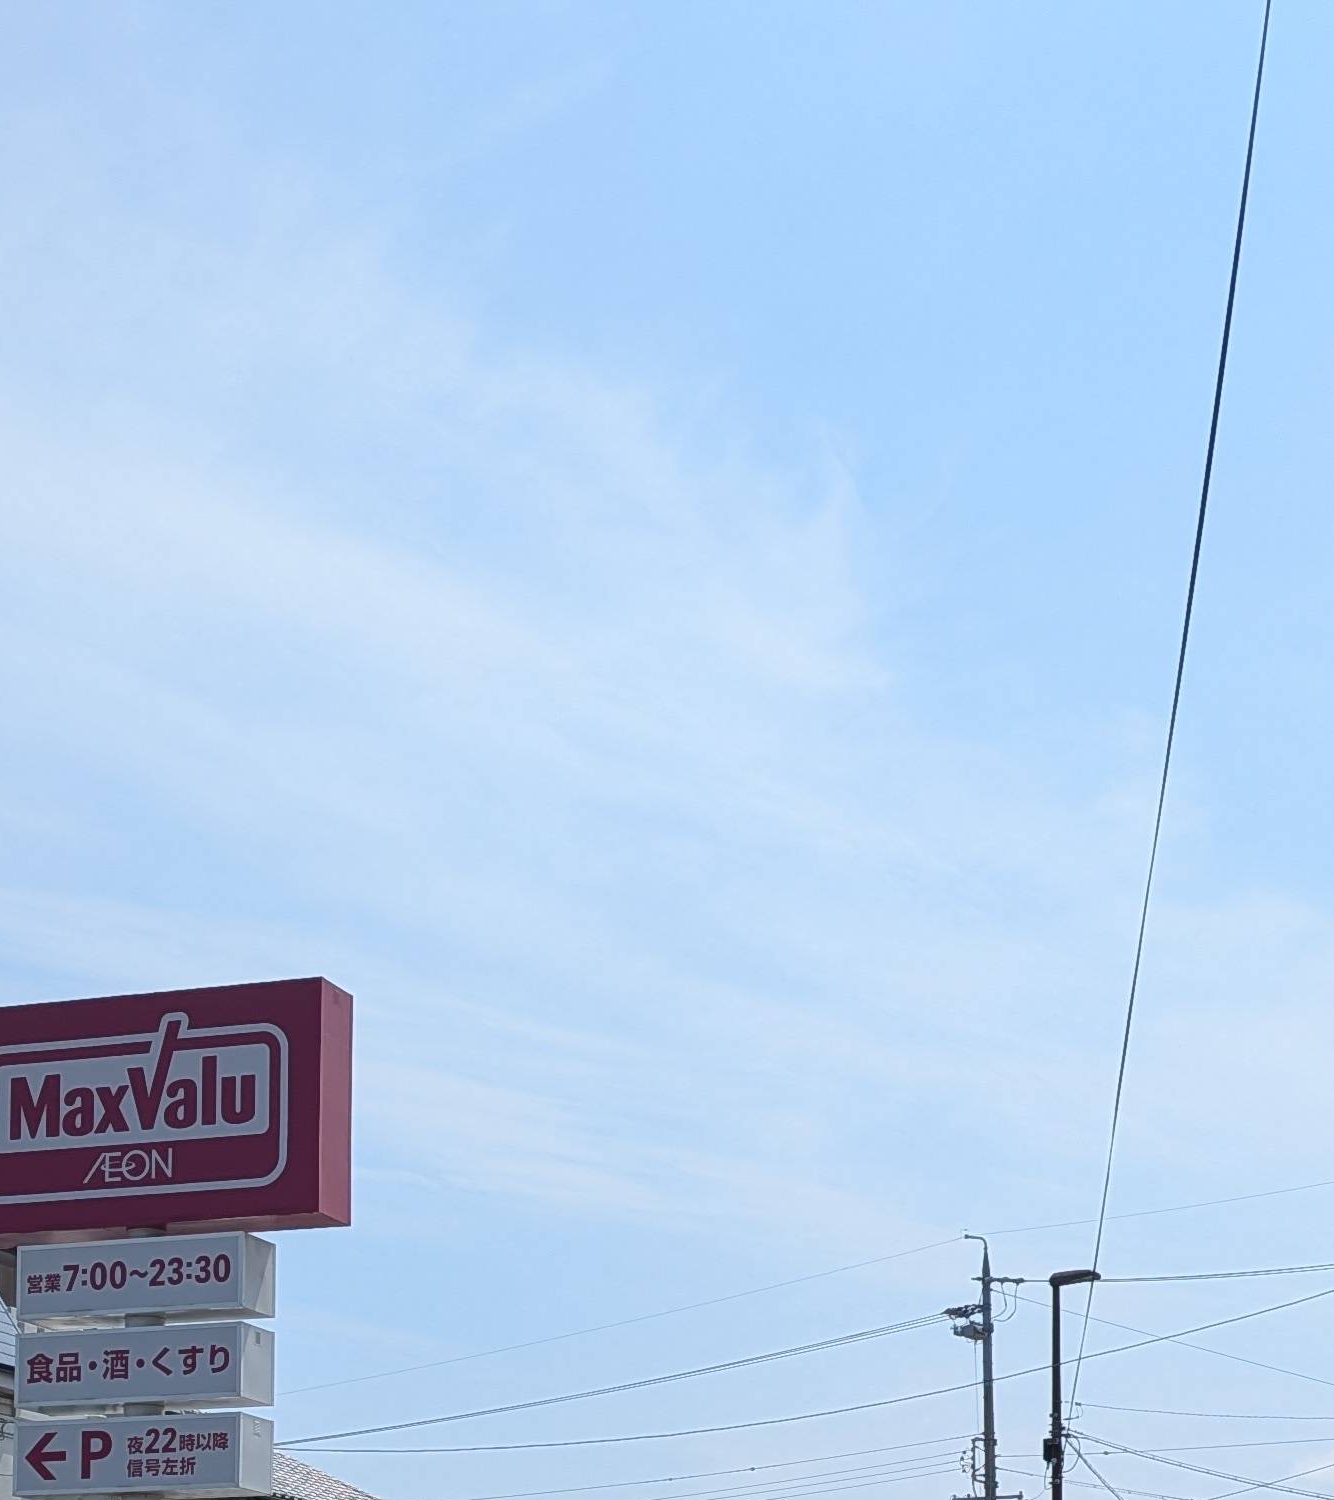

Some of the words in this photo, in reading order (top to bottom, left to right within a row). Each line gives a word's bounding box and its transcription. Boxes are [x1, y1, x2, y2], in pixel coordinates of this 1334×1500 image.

[10, 1020, 256, 1140] MaxValu
[26, 1344, 230, 1384] 食品・酒・くすり
[80, 1430, 113, 1480] P
[127, 1427, 229, 1455] 夜22時以降
[126, 1456, 197, 1478] 信号左折
